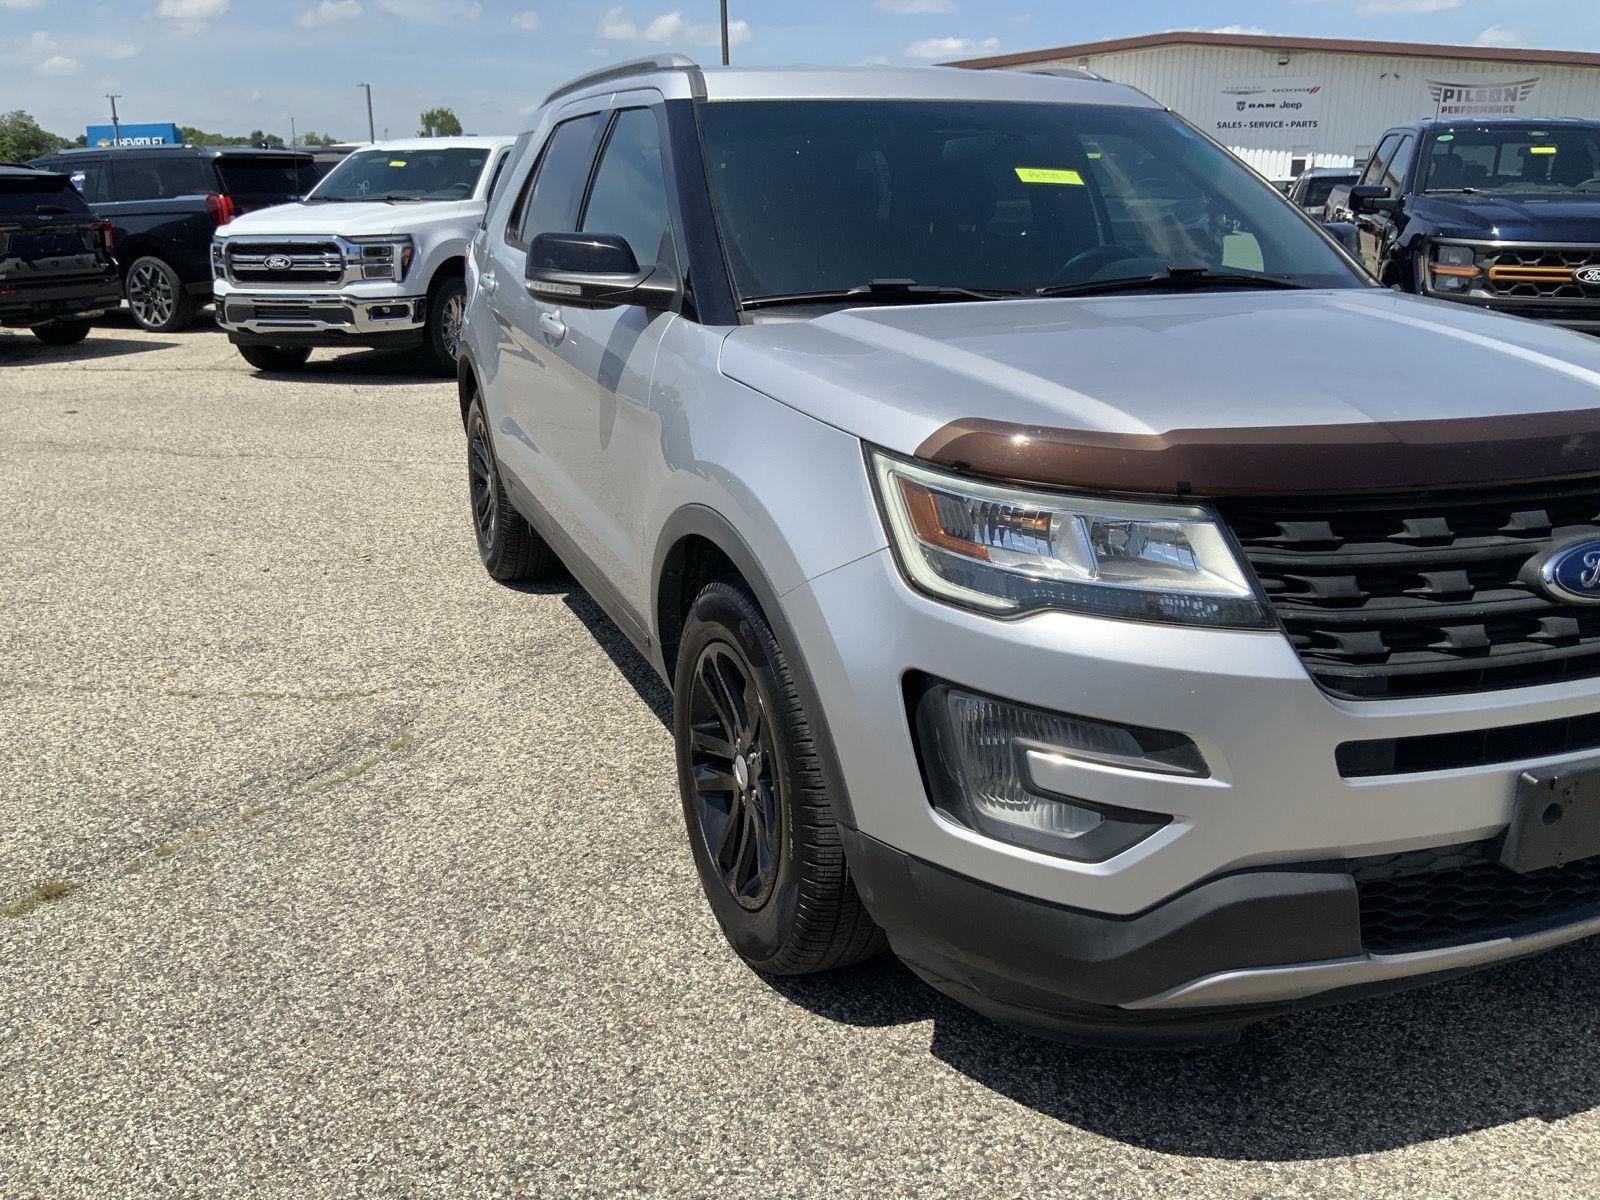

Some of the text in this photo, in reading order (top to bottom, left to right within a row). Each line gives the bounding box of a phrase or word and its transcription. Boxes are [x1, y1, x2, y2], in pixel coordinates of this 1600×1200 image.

[1442, 87, 1519, 102] PILSON
[1279, 101, 1303, 110] Jeep
[1441, 105, 1516, 113] PERFORMANCE
[1216, 120, 1318, 129] SALES SERVICE PARTS
